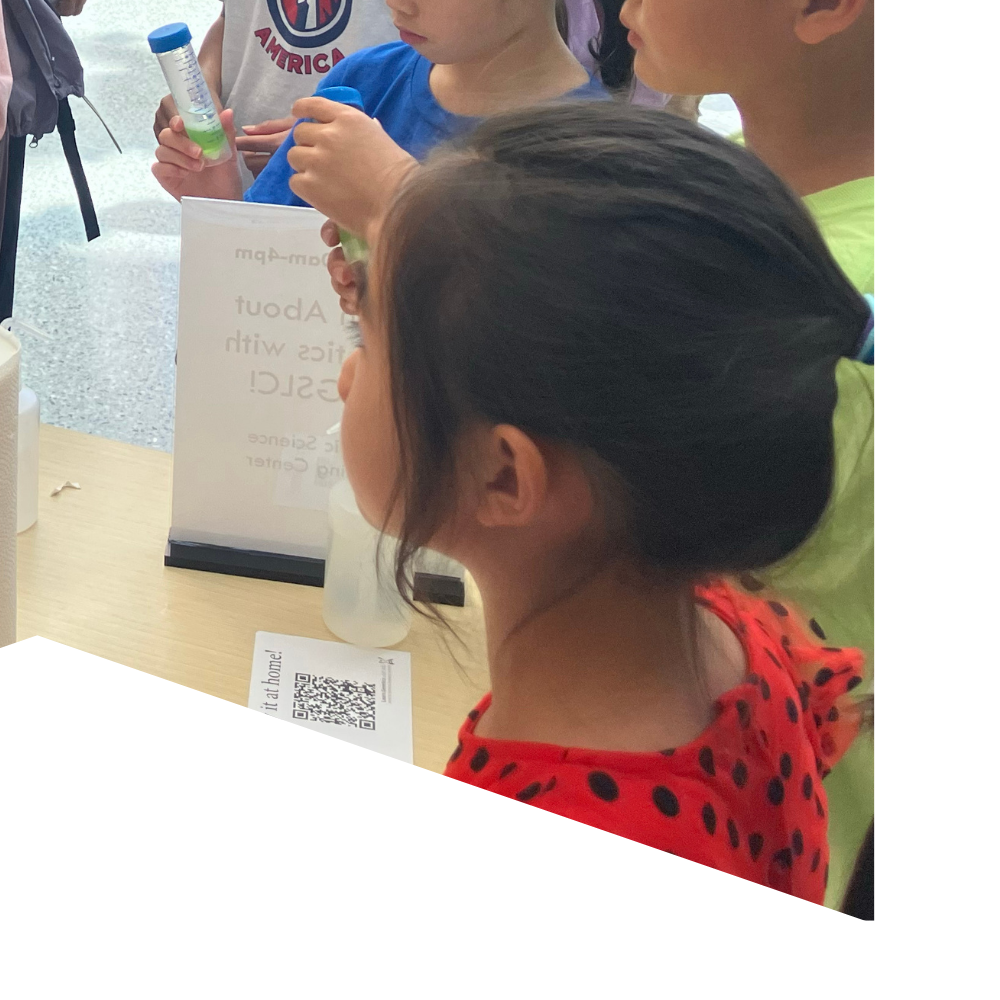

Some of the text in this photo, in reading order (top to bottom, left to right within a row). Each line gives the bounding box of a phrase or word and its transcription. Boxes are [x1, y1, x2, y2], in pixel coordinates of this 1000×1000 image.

[254, 27, 346, 75] AMERICA
[260, 650, 282, 712] it at home!
